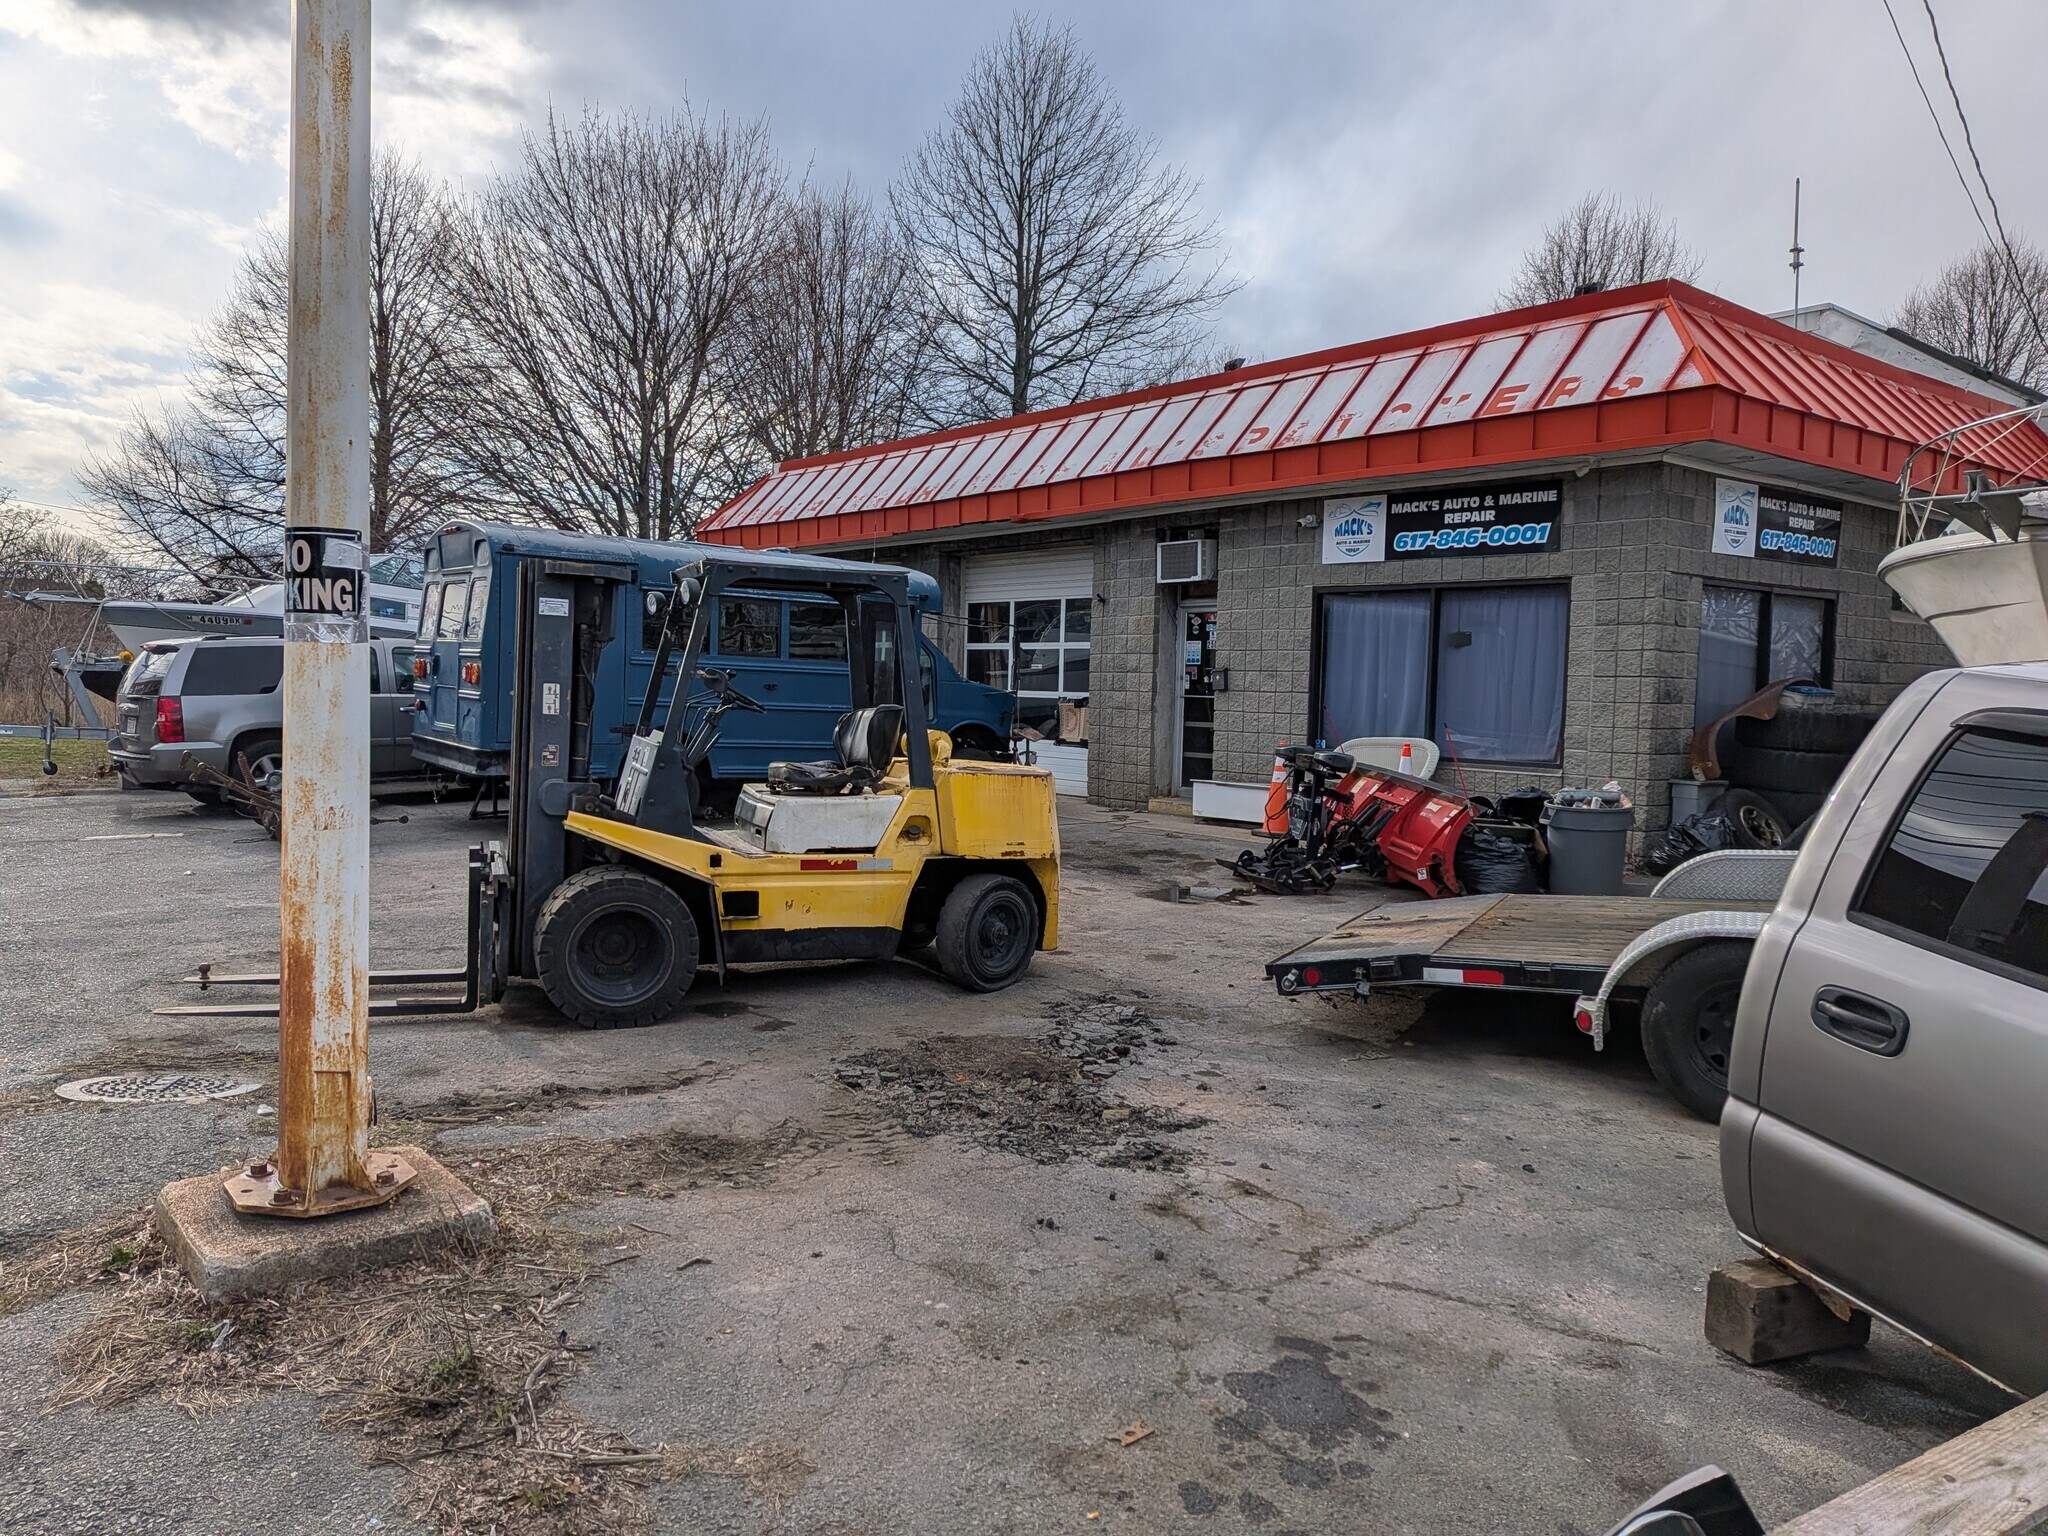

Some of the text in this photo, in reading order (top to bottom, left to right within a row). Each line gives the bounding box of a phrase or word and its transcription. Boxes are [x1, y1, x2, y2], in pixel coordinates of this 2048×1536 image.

[1391, 490, 1558, 515] MACK'S AUTO & MARINE
[1760, 497, 1841, 521] MACK'S AUTO & MARINE
[1444, 510, 1496, 524] REPAIR
[1723, 504, 1750, 526] MACK'S
[1788, 516, 1815, 531] REPAIR
[1334, 517, 1374, 538] MACK'S
[1393, 522, 1552, 552] 617-846-0001
[1760, 528, 1837, 559] 617-846-0001
[286, 577, 353, 611] KING
